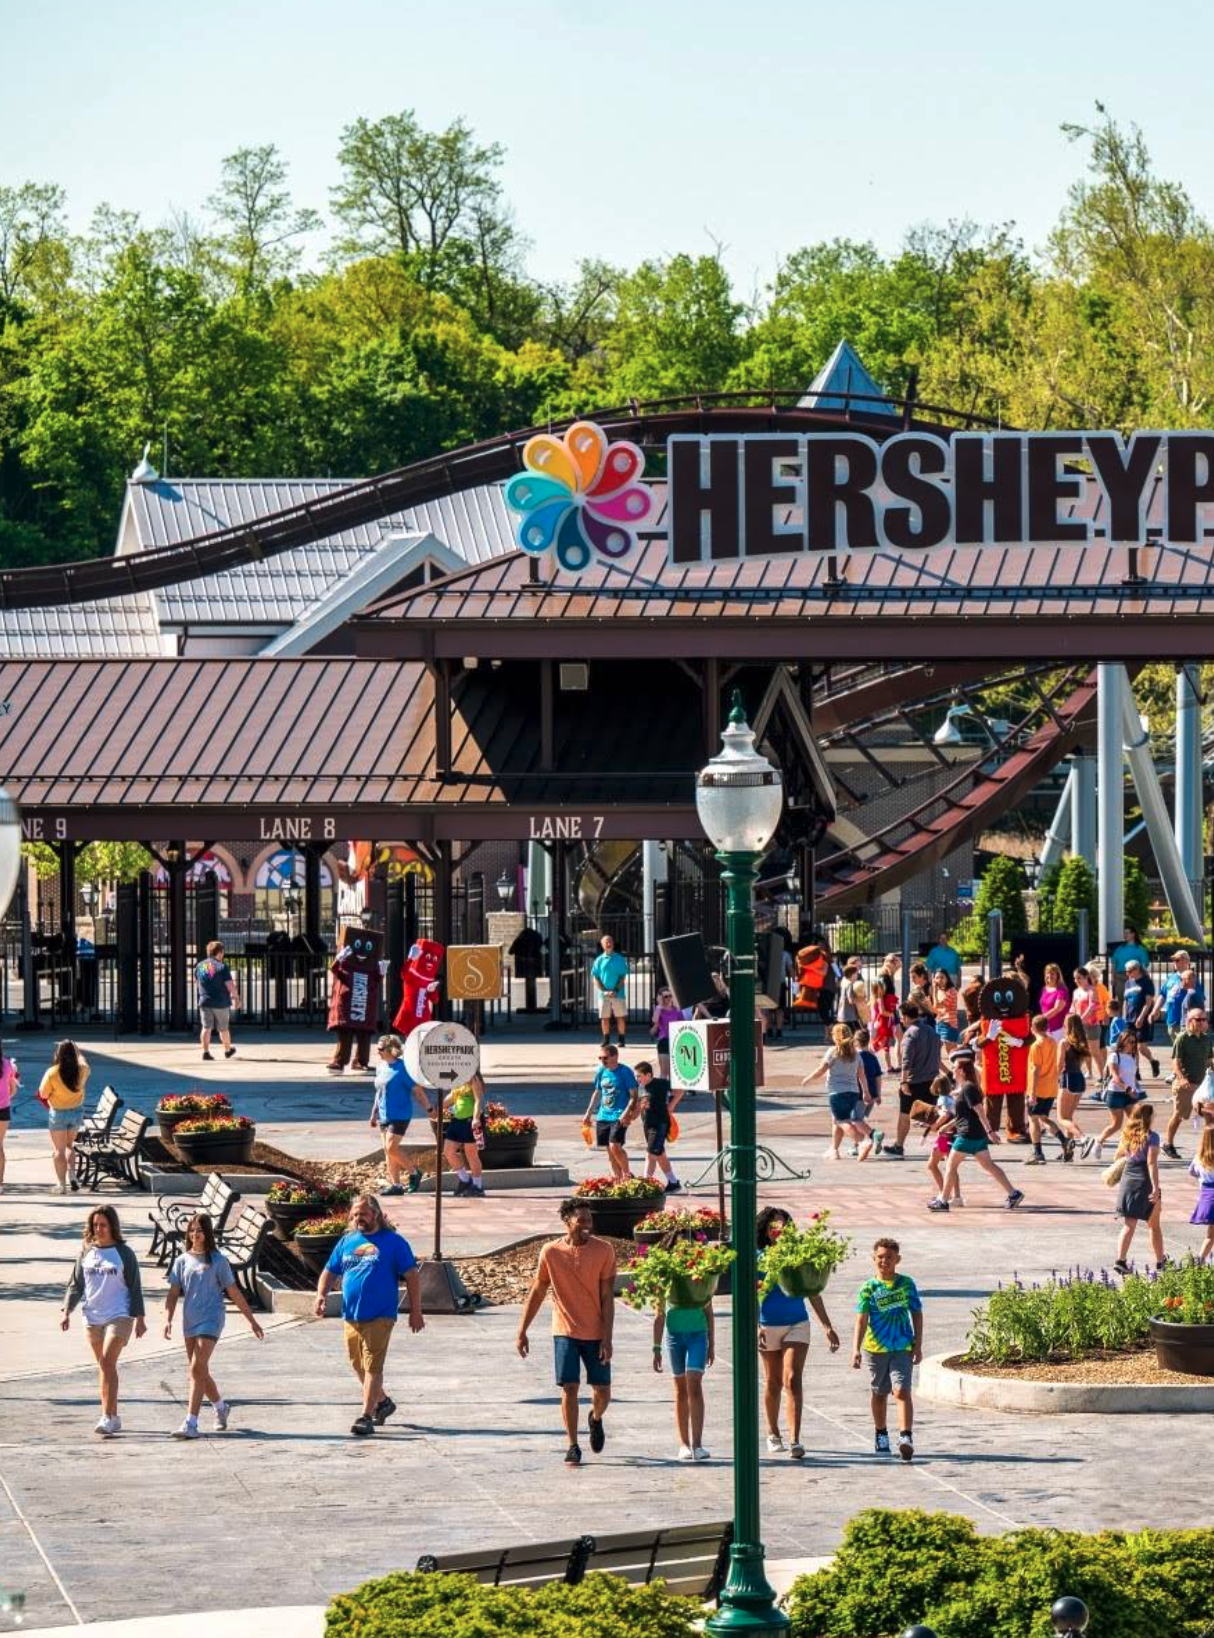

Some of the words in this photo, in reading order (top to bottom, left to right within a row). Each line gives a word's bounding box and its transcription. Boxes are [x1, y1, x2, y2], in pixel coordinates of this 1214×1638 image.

[21, 818, 43, 839] NE
[56, 818, 67, 839] 9
[260, 818, 311, 839] LANE
[324, 818, 336, 839] 8
[529, 817, 582, 839] LANE
[593, 817, 605, 838] 7
[424, 1045, 475, 1055] HERSHEYPARK
